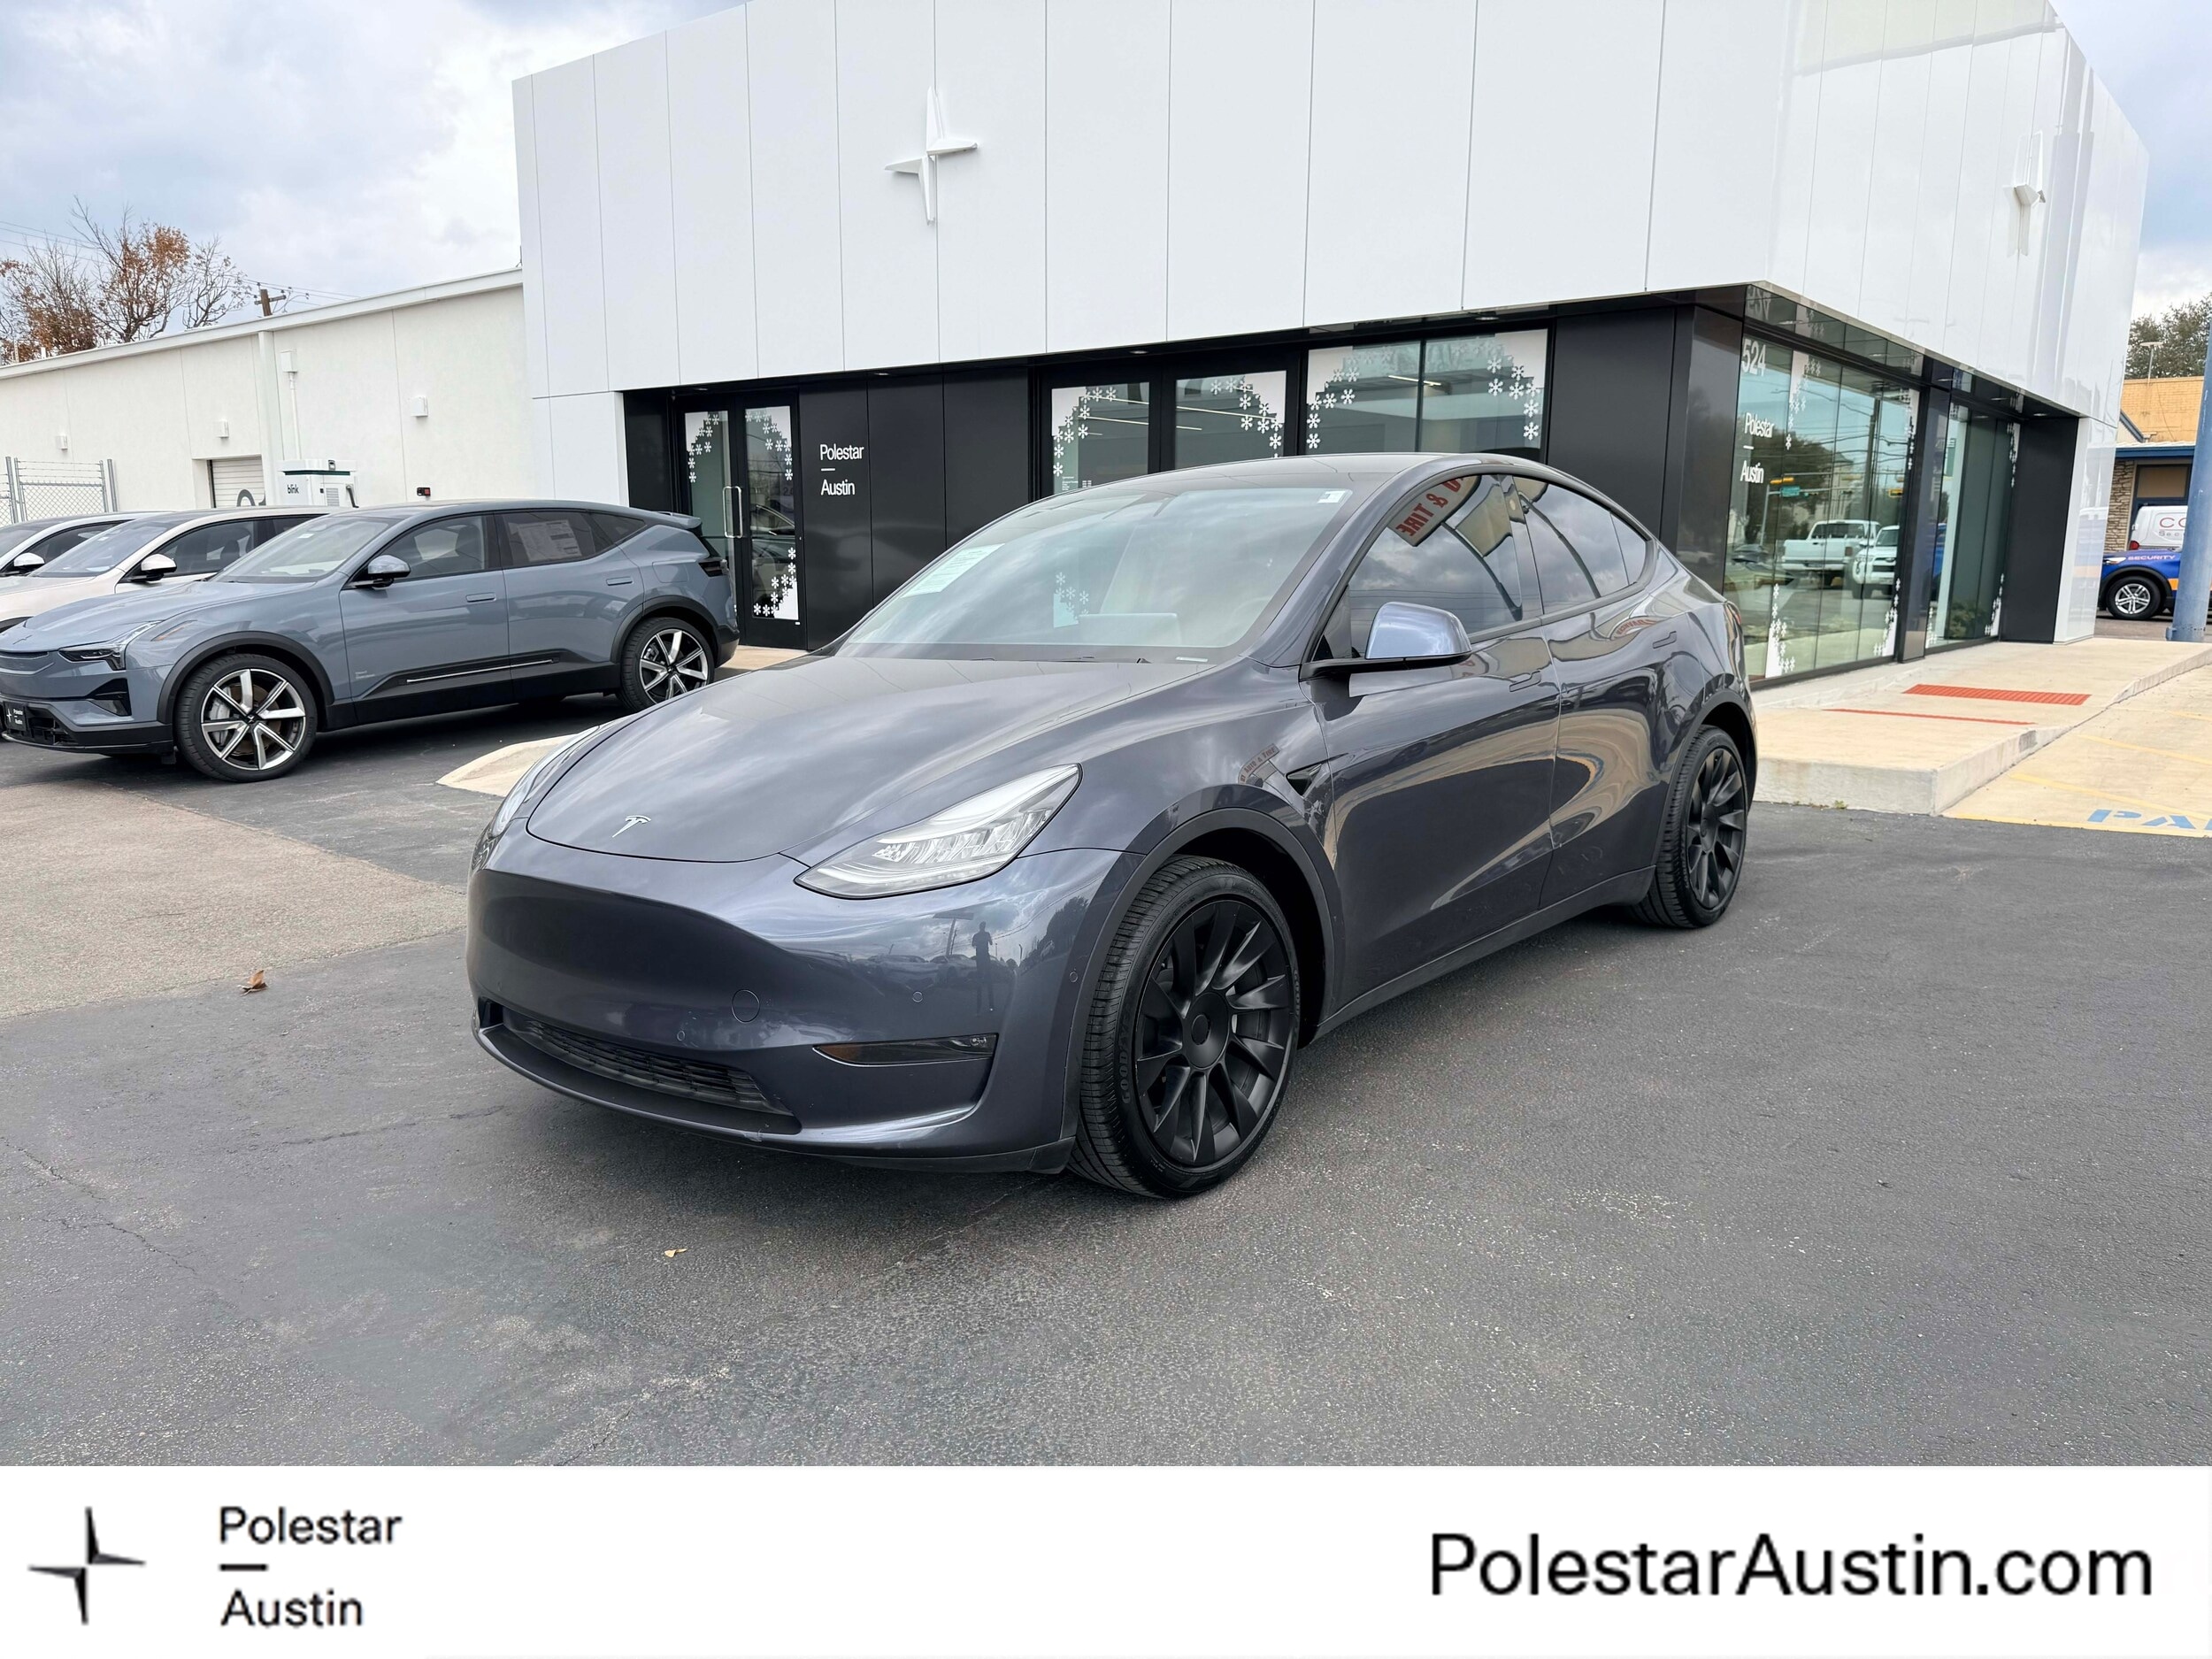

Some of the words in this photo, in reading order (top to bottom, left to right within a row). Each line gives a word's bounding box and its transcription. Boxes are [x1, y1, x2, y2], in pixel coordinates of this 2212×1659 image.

[1741, 338, 1766, 376] 524
[1744, 412, 1775, 438] Polestar
[820, 443, 864, 460] Polestar
[1740, 460, 1764, 483] Austin
[287, 484, 299, 494] blink
[821, 479, 856, 495] Austin
